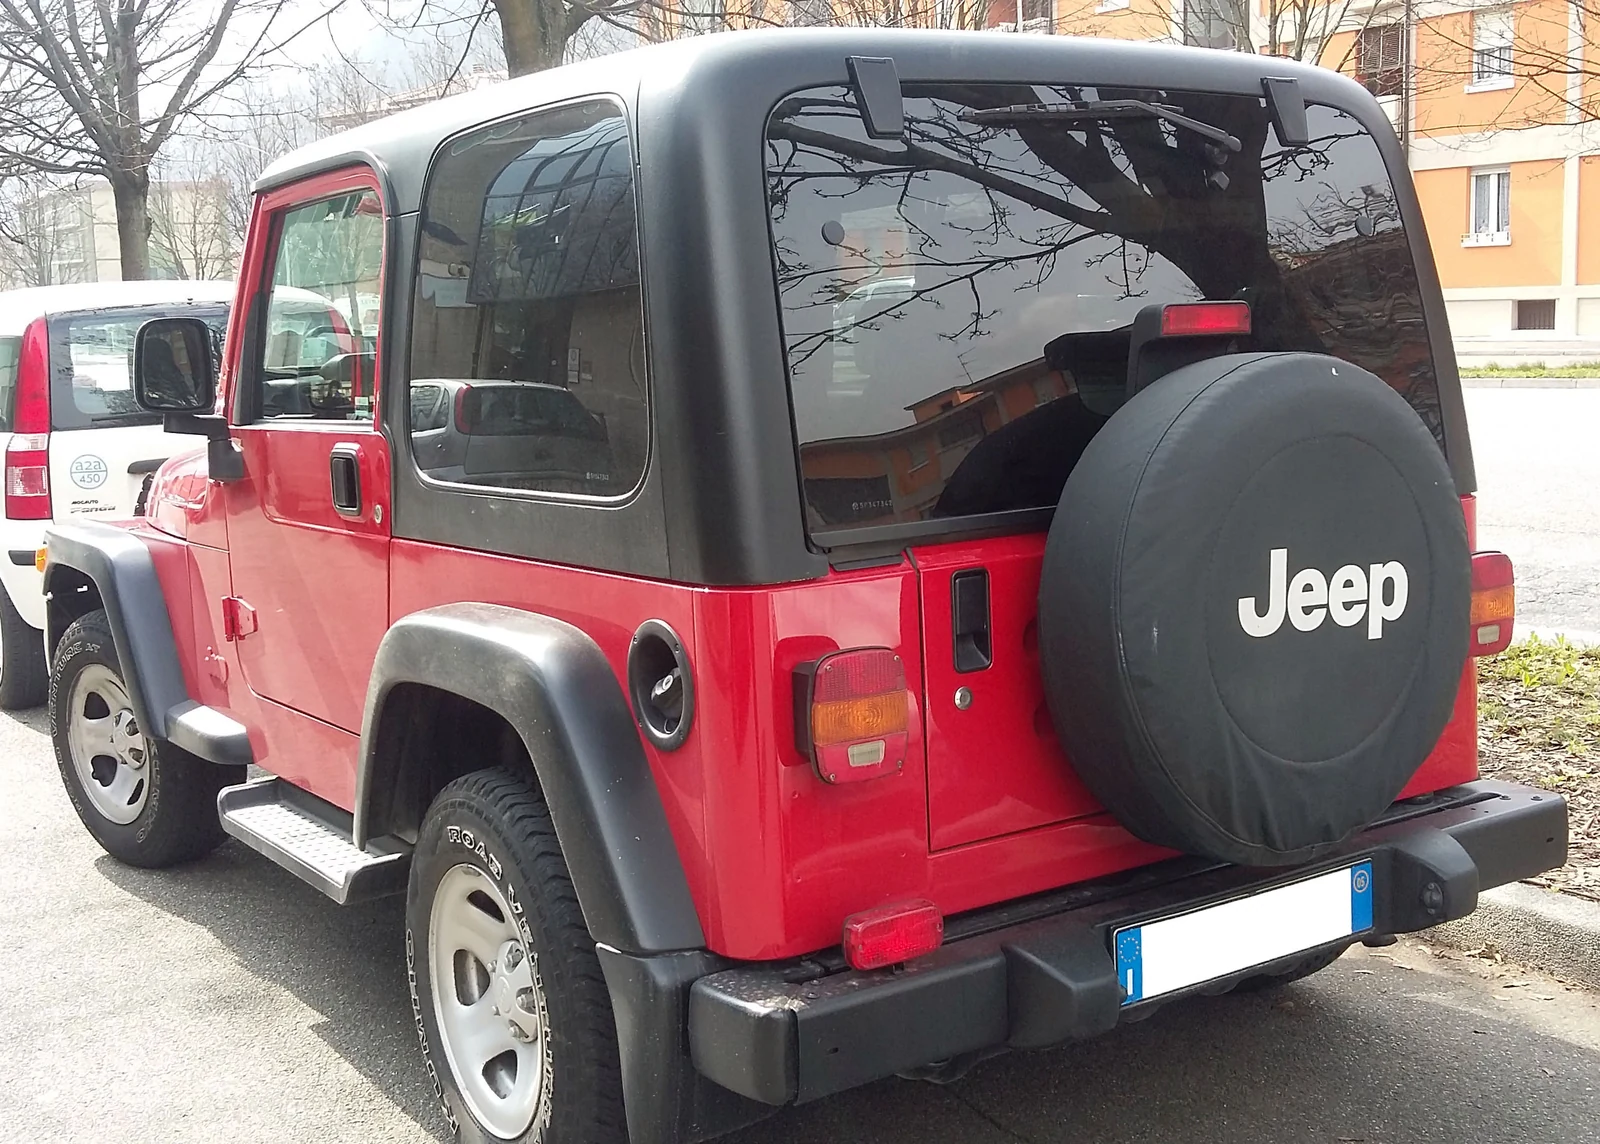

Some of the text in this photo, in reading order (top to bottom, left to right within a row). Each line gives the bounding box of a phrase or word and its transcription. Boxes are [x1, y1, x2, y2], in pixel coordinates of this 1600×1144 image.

[75, 460, 102, 471] a2a
[79, 473, 101, 484] 450
[1238, 548, 1409, 640] Jeep
[446, 825, 503, 881] ROAD
[405, 927, 461, 1135] KUMHO
